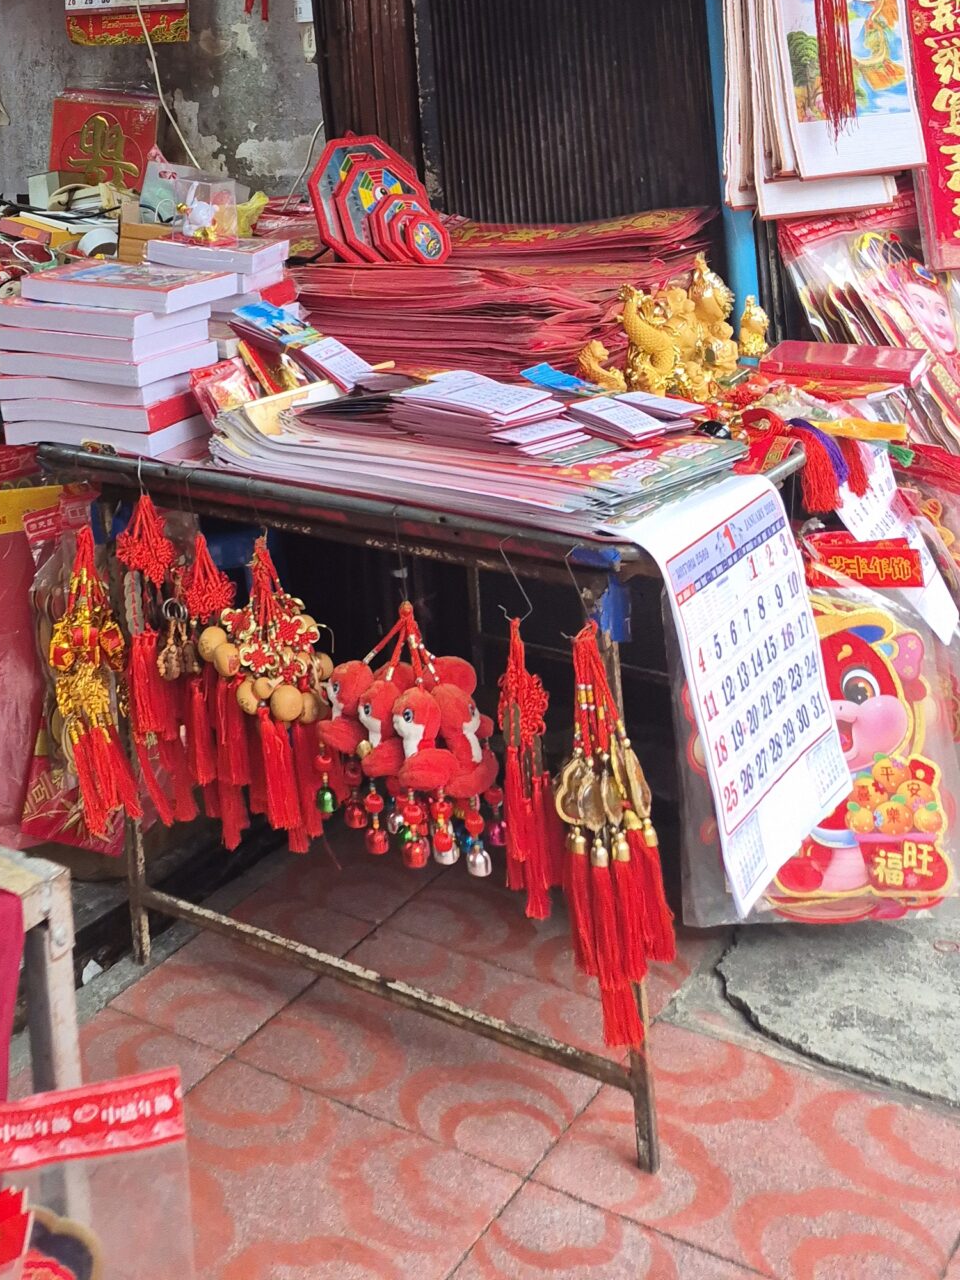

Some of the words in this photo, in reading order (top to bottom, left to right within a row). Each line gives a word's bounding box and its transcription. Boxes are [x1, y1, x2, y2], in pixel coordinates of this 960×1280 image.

[722, 524, 737, 550] 1
[747, 554, 758, 580] 1
[765, 544, 775, 566] 2
[779, 533, 788, 557] 3
[698, 647, 706, 672] 4
[713, 632, 722, 660] 5
[730, 620, 737, 646] 6
[744, 608, 751, 632] 7
[757, 595, 766, 620] 8
[775, 584, 783, 608] 9
[787, 571, 799, 599] 10
[703, 690, 720, 722] 11
[721, 675, 736, 707] 12
[737, 661, 750, 692] 13
[751, 648, 764, 678] 14
[764, 635, 777, 664] 15
[781, 622, 795, 652] 16
[797, 611, 809, 639] 17
[714, 735, 728, 768] 18
[731, 719, 745, 752] 19
[746, 704, 759, 736] 20
[760, 690, 773, 720] 21
[772, 676, 786, 705] 22
[788, 663, 803, 692] 23
[804, 650, 818, 678] 24
[723, 780, 739, 813] 25
[740, 763, 754, 796] 26
[755, 747, 768, 779] 27
[769, 732, 783, 764] 28
[782, 718, 796, 748] 29
[796, 704, 810, 734] 30
[810, 691, 826, 720] 31
[880, 766, 895, 781] 平
[907, 782, 921, 797] 安
[887, 807, 901, 824] 樂
